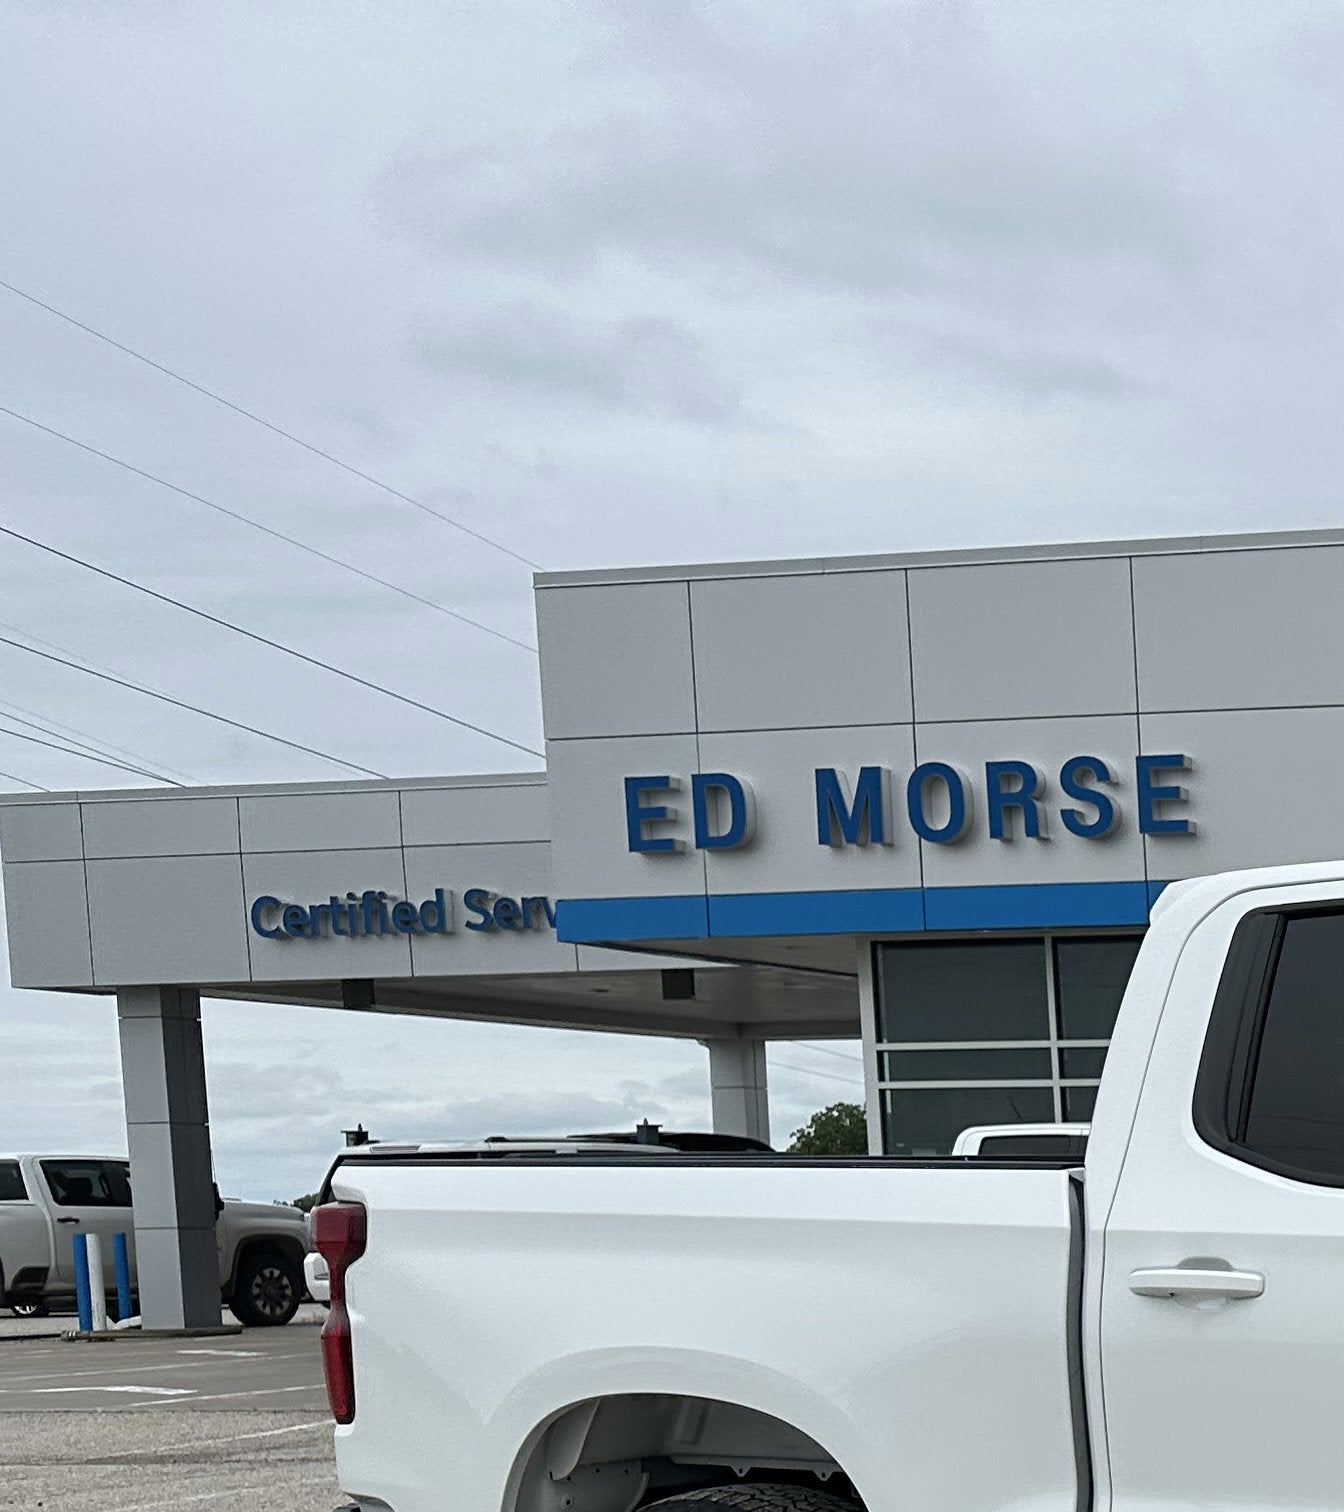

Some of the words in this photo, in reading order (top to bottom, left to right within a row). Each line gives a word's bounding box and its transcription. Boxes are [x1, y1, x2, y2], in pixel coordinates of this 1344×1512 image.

[623, 772, 753, 853] ED
[815, 753, 1194, 846] MORSE
[250, 888, 448, 939] Certified
